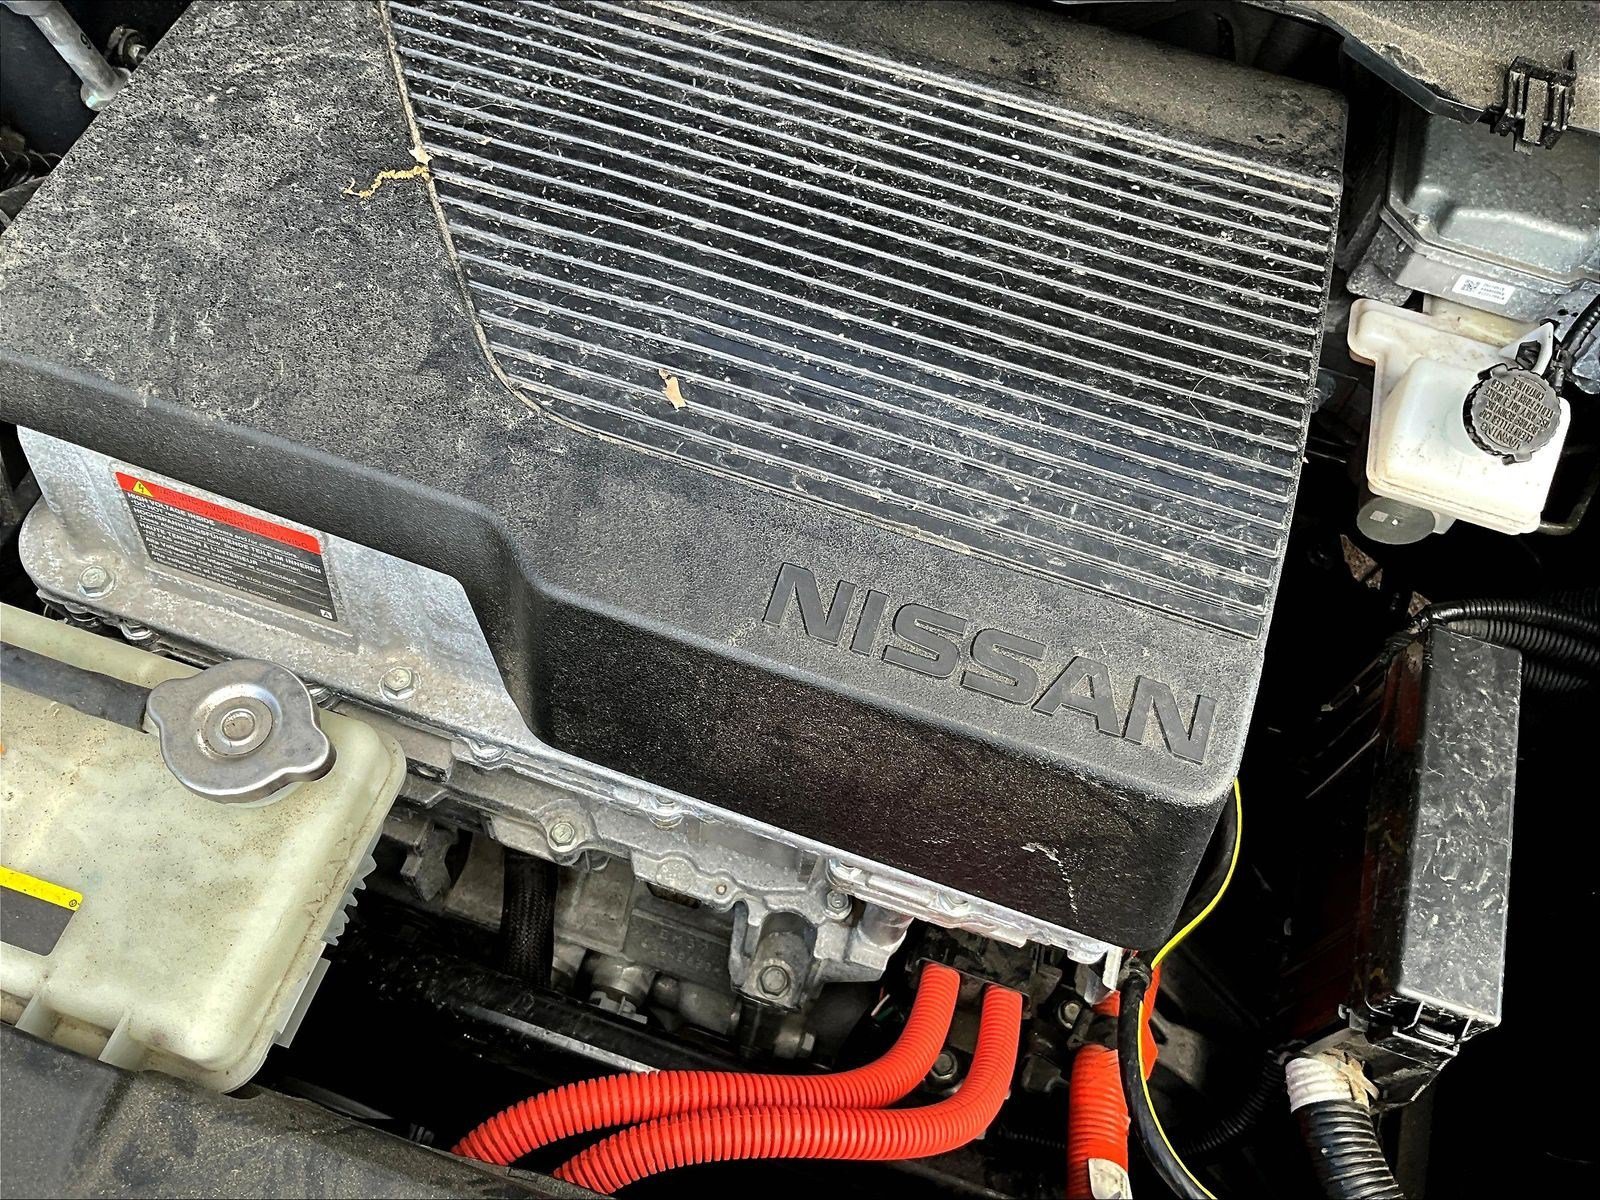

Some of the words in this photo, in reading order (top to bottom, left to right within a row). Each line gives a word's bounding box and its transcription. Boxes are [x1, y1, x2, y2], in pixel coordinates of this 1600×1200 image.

[1491, 379, 1513, 396] SEALED
[1511, 377, 1545, 401] CONTAINER
[1518, 393, 1535, 408] FROM
[1534, 402, 1554, 418] FLUID
[1491, 414, 1515, 433] FILLER
[1515, 417, 1539, 435] BEFORE
[1481, 422, 1522, 449] WARNING
[1514, 427, 1534, 443] CLEAN
[126, 491, 149, 504] HIGH
[148, 499, 186, 516] VOLTAGE
[187, 511, 215, 526] INSIDE
[146, 504, 164, 514] NOT
[138, 521, 166, 535] HAUTE
[166, 530, 202, 547] TENSION
[250, 545, 272, 557] TEILE
[273, 553, 283, 561] IM
[284, 557, 321, 573] INNEREN
[762, 562, 1217, 765] NISSAN
